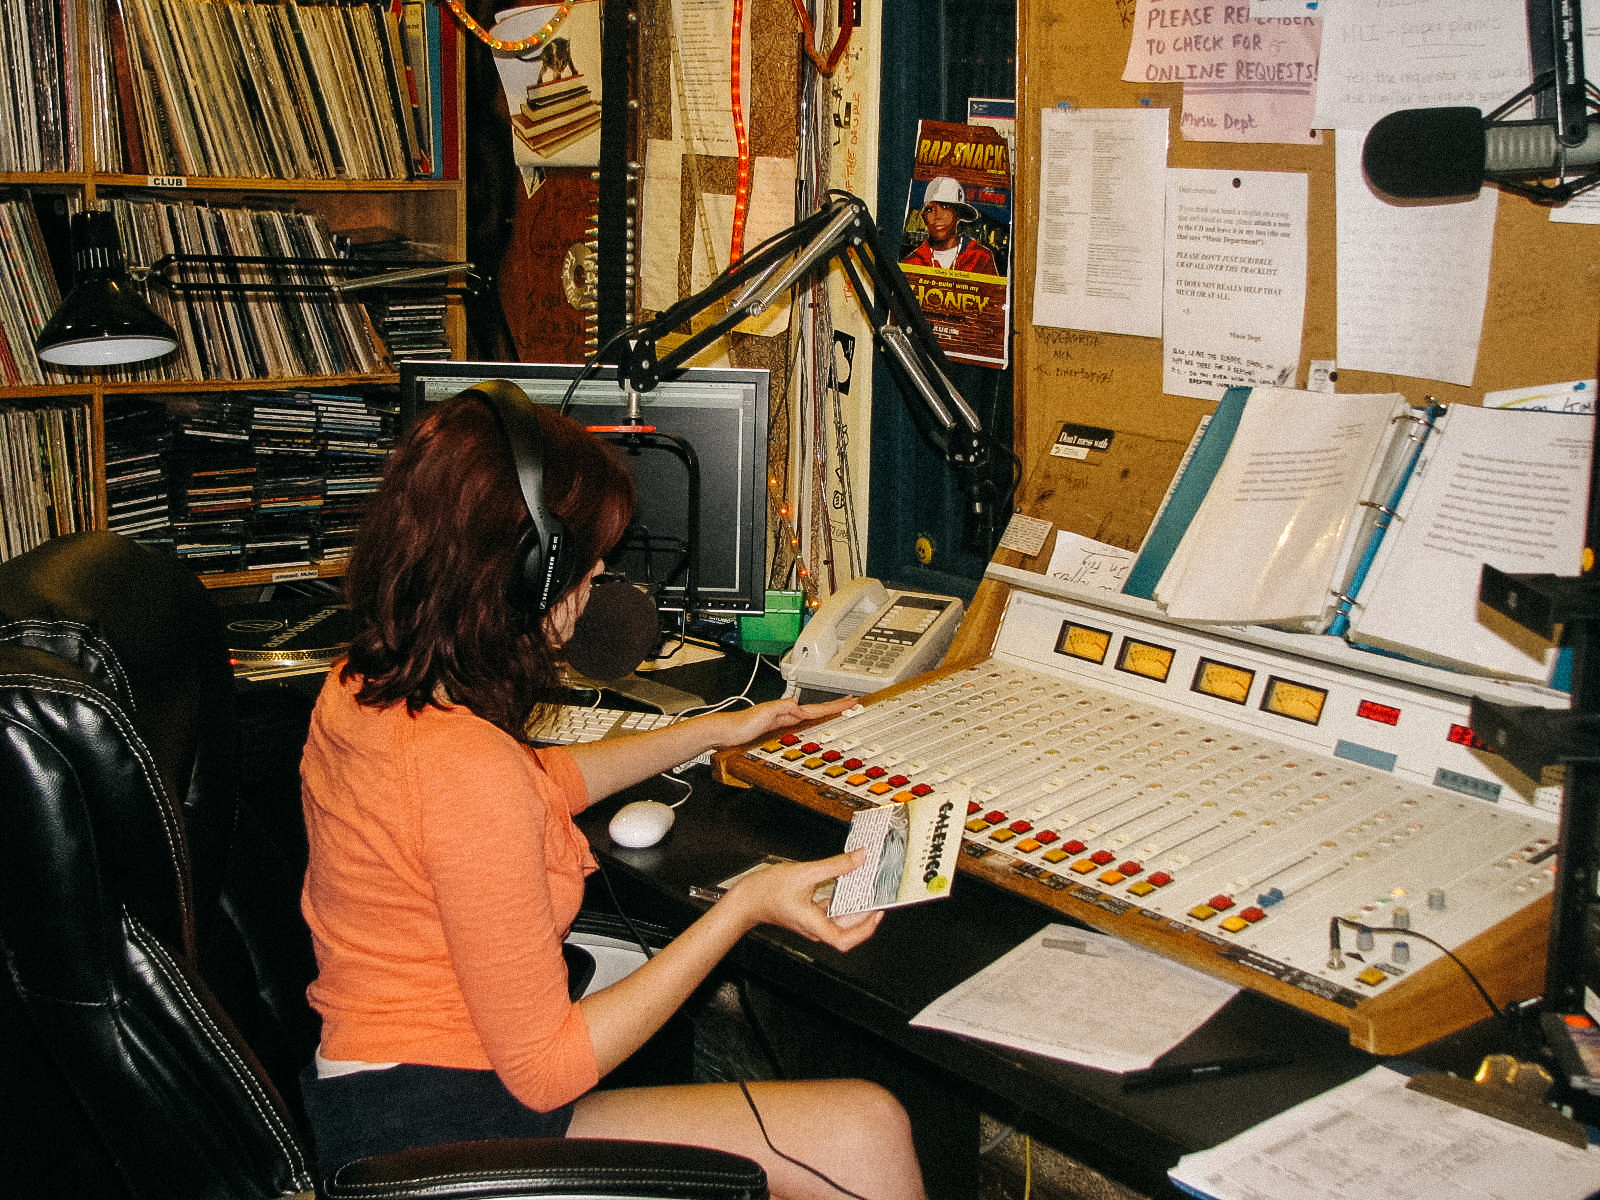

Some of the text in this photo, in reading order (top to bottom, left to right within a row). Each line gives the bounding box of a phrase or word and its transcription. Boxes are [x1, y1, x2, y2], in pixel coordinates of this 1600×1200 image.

[1147, 6, 1215, 29] PLEASE
[1146, 33, 1262, 56] TO CHECK FOR
[1145, 56, 1320, 82] ONLINE REQUESTS!
[1182, 111, 1258, 133] Music Dept
[918, 139, 952, 164] RAP
[153, 177, 183, 187] CLUB
[1176, 251, 1199, 261] PLEASE
[1222, 255, 1238, 263] JUST
[1240, 257, 1273, 266] SCRIBBLE
[1206, 264, 1223, 272] OVER
[1175, 288, 1195, 297] MUCH
[1184, 280, 1201, 289] DOES
[1202, 281, 1215, 290] NOT
[1216, 283, 1243, 293] REALLY
[1243, 285, 1263, 295] HELP
[1263, 287, 1282, 297] THAT
[1058, 431, 1078, 444] Don't
[1093, 437, 1109, 449] with
[542, 556, 555, 601] SENNHEISER
[922, 800, 954, 884] CALEXICO
